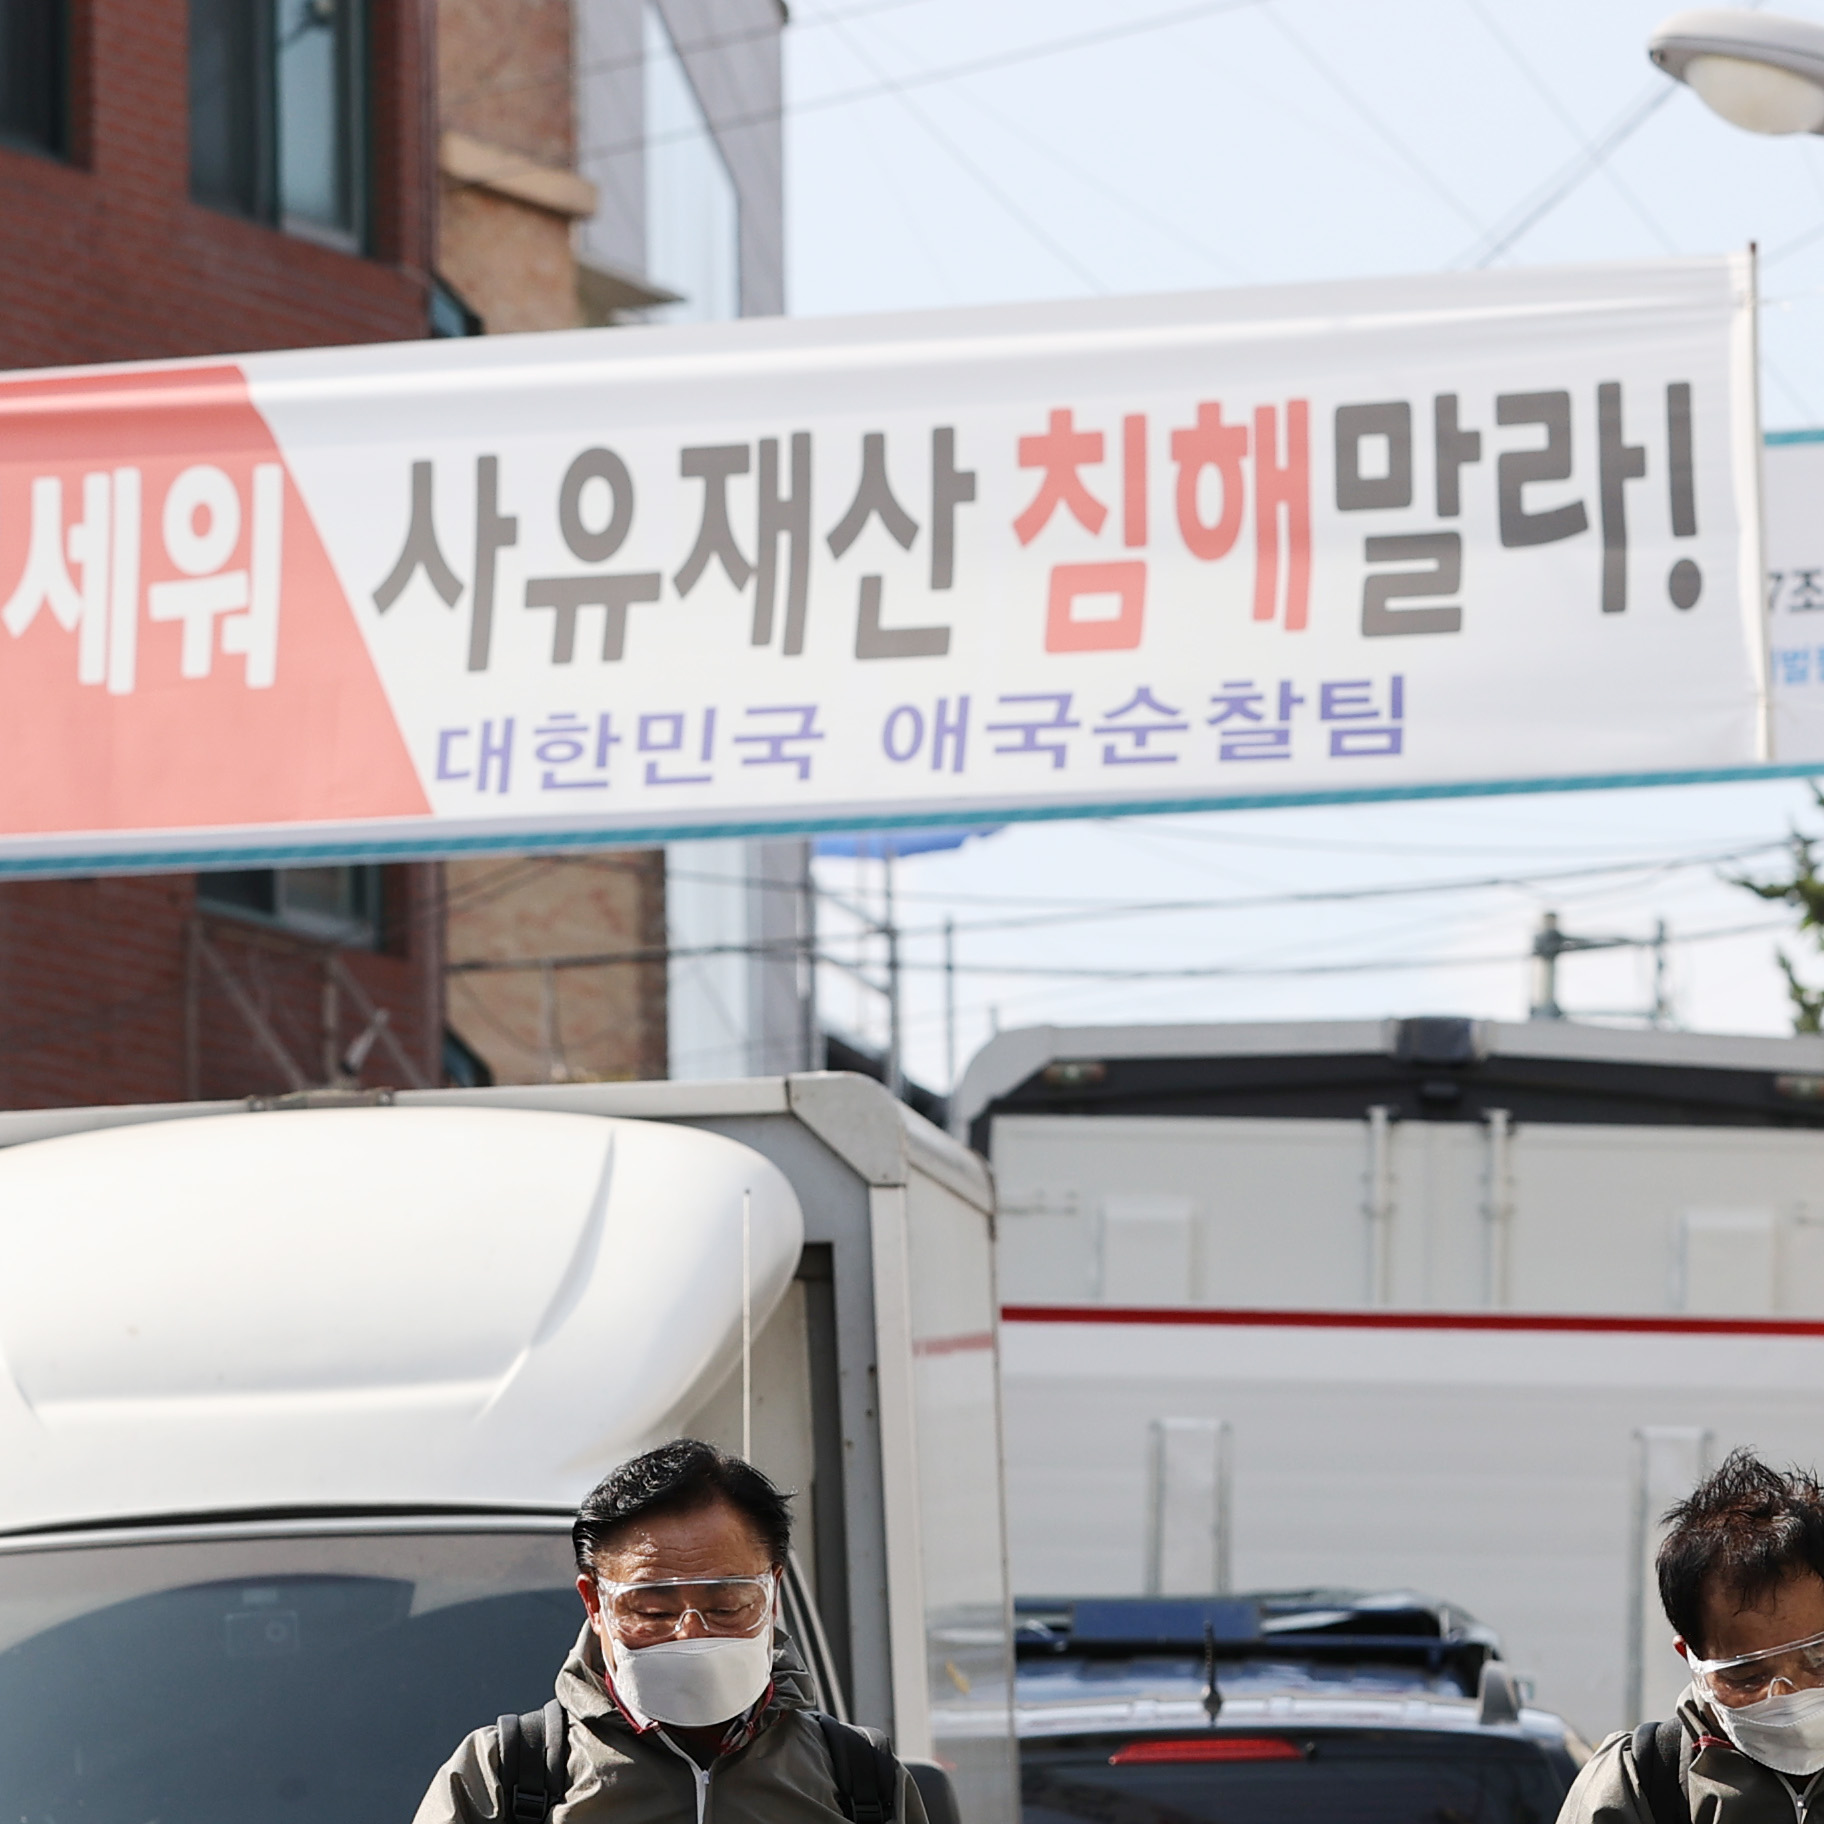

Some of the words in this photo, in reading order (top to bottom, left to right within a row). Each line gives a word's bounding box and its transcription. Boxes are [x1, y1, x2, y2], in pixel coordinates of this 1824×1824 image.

[371, 426, 977, 672] 사유재산
[435, 702, 826, 795] 대한민국
[881, 672, 1407, 774] 애국순찰팀
